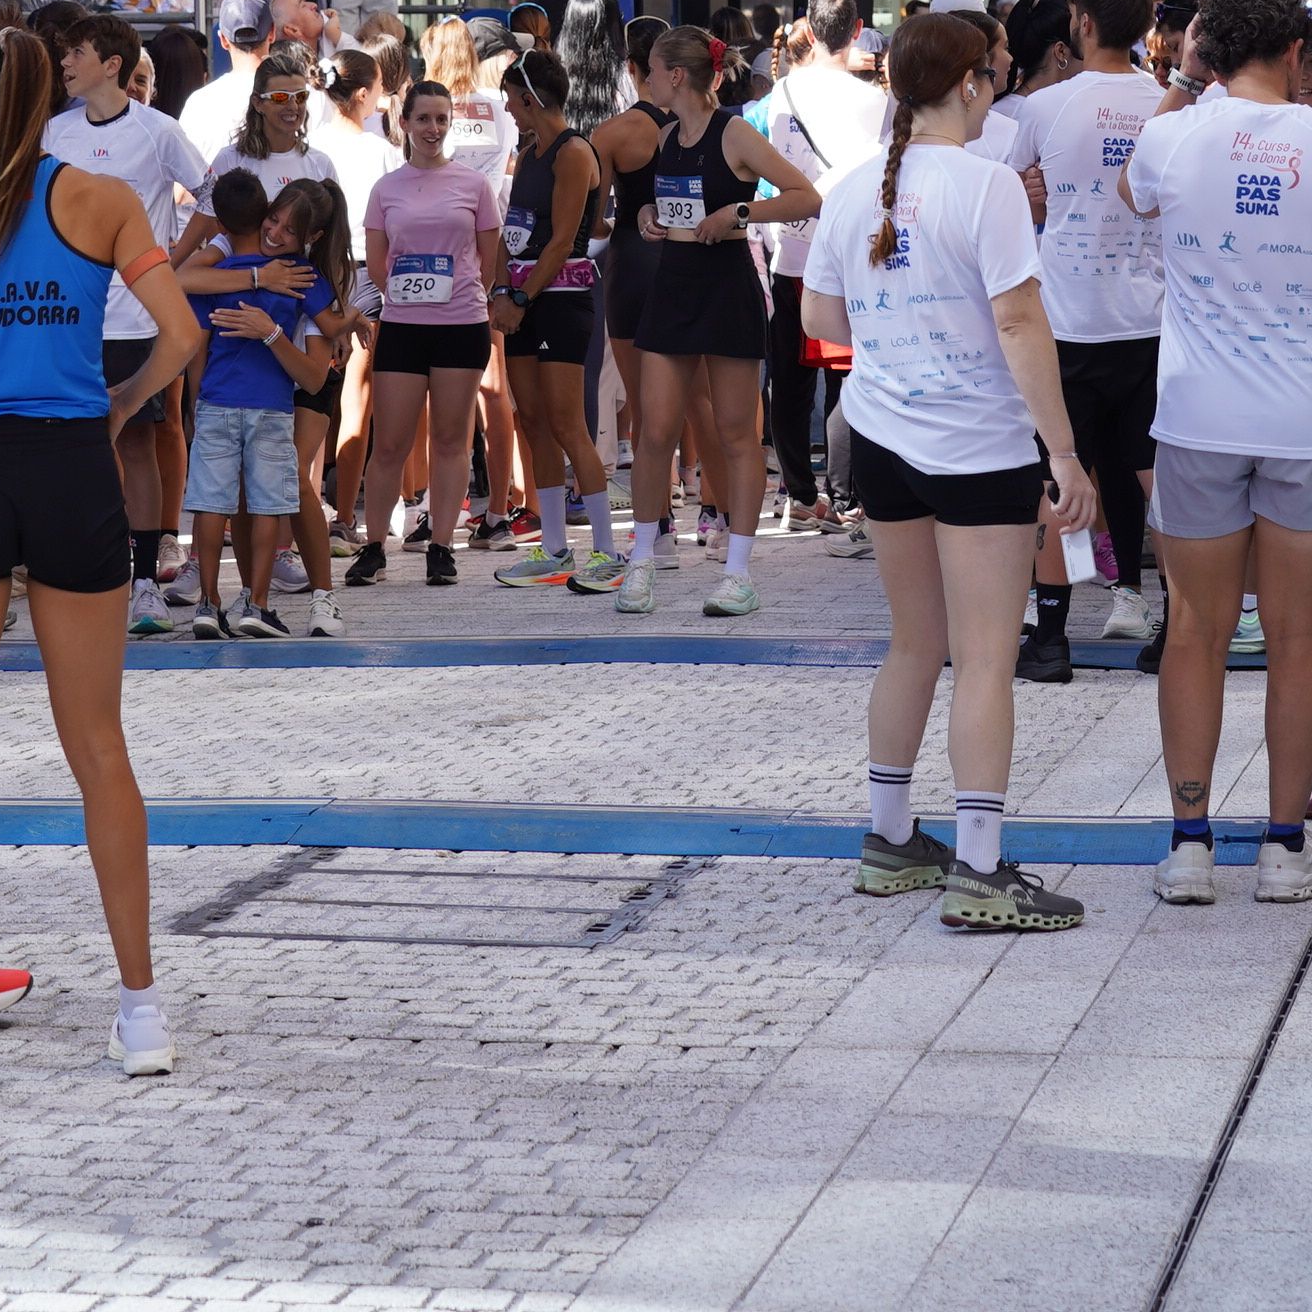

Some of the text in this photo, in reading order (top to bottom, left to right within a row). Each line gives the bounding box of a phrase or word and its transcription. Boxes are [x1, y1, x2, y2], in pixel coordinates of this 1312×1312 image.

[1115, 113, 1138, 122] Cursa
[1118, 122, 1136, 131] Dona
[1104, 138, 1135, 147] CADA
[1258, 140, 1290, 152] Cursa
[1230, 151, 1286, 164] de la Dona
[1238, 174, 1281, 186] CADA
[1236, 187, 1280, 201] PAS
[667, 202, 693, 219] 303
[1236, 202, 1279, 216] SUMA
[1270, 244, 1301, 254] MORA
[402, 277, 435, 293] 250
